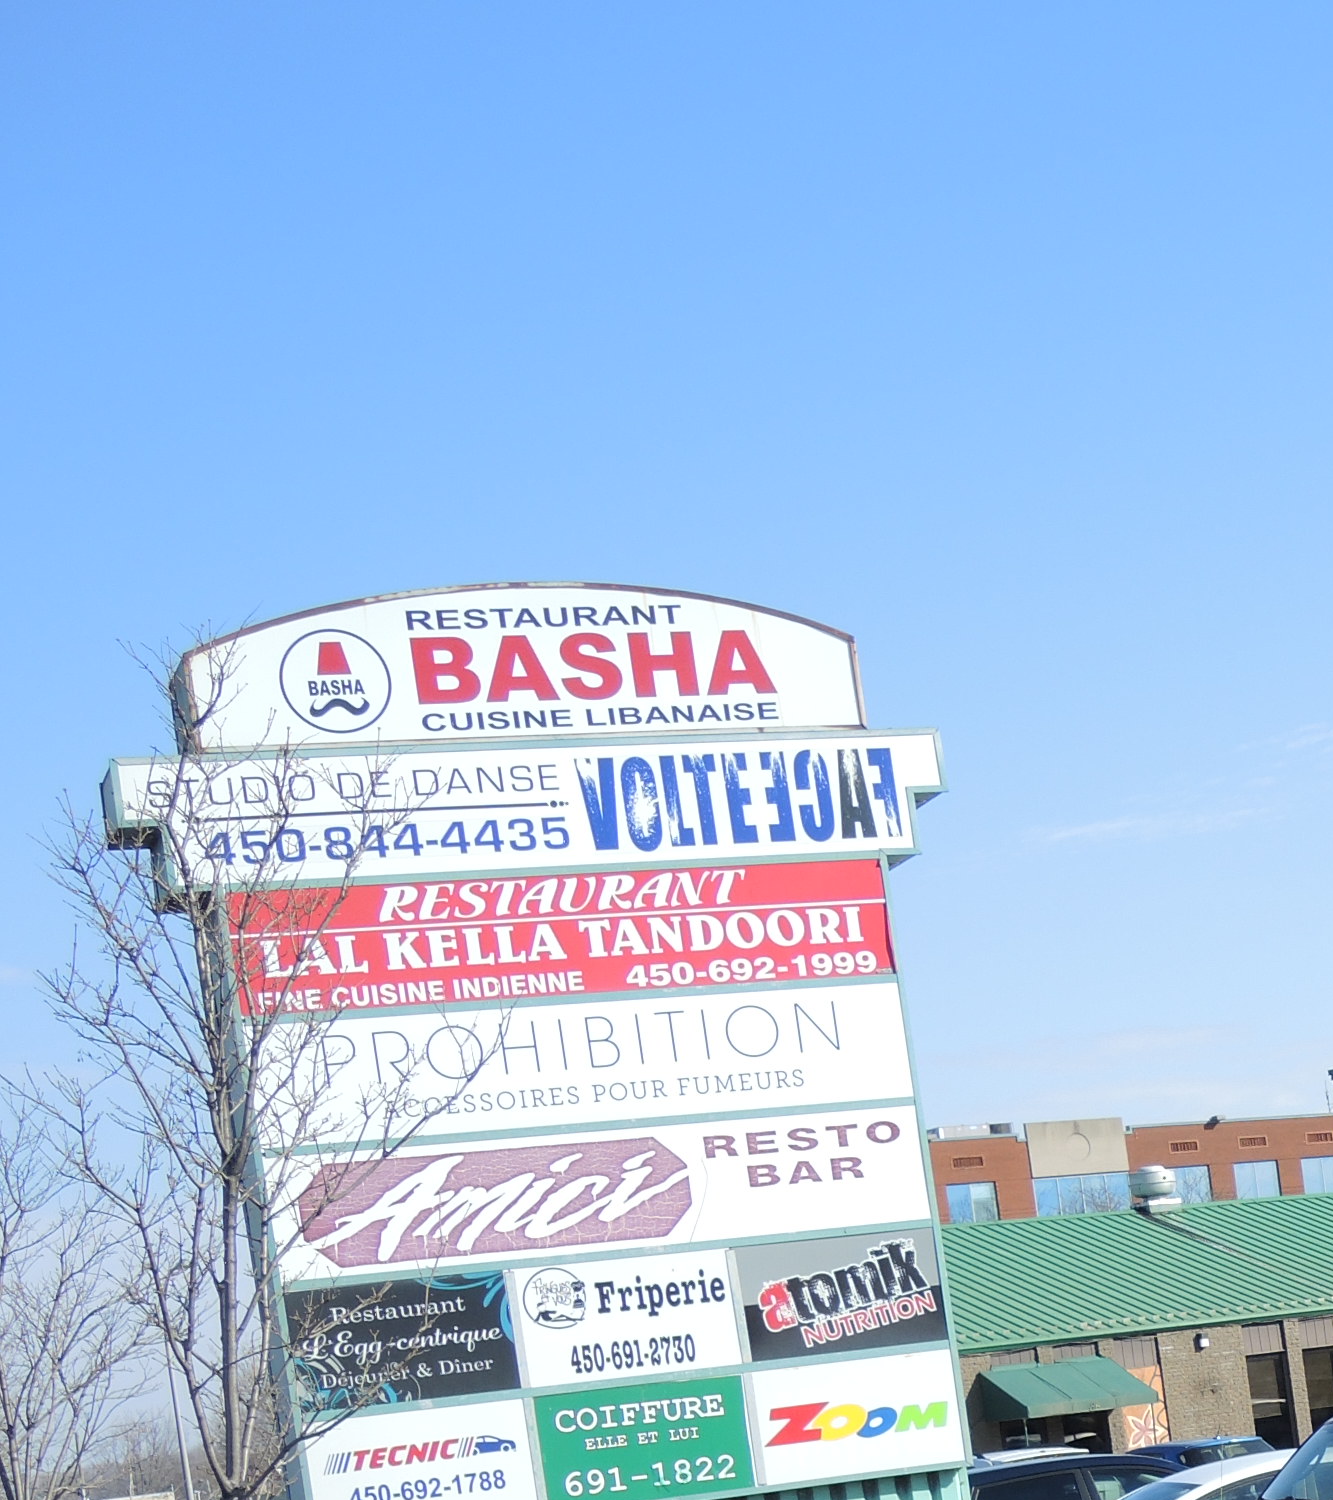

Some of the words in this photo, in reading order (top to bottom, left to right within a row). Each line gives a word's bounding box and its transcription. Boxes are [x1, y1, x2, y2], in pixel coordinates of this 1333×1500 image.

[405, 604, 682, 631] RESTAURANT
[308, 679, 365, 697] BASHA
[409, 629, 779, 705] BASHA
[422, 706, 573, 732] CUISINE
[586, 701, 779, 726] LIBANAISE
[147, 772, 316, 808] STUDIO
[337, 771, 393, 800] DE
[412, 762, 560, 797] DANSE
[203, 815, 572, 866] 450-844-4435
[378, 868, 746, 924] RESTAURANT
[258, 934, 369, 979] LAL
[383, 924, 567, 971] KELLA
[579, 905, 865, 959] TANDOORI
[625, 949, 878, 990] 450-692-1999
[257, 988, 325, 1013] FINE
[331, 980, 445, 1008] CUISINE
[452, 970, 585, 1000] INDIENNE
[320, 1001, 842, 1089] PROHIBITION
[385, 1086, 580, 1119] ACCESSOIRES
[592, 1078, 669, 1103] POUR
[677, 1068, 806, 1097] FUMEURS
[703, 1120, 901, 1158] RESTO
[746, 1156, 865, 1188] BAR
[315, 1150, 690, 1262] Amici
[329, 1296, 466, 1326] Restaurant
[594, 1269, 726, 1318] Friperie
[801, 1290, 938, 1347] NUTRITION
[416, 1363, 433, 1377] &
[438, 1357, 494, 1376] Dîner
[570, 1333, 696, 1374] 450-691-2730
[554, 1394, 724, 1433] COIFFURE
[765, 1401, 948, 1447] ZOOM
[352, 1438, 459, 1472] TECNIC
[585, 1434, 628, 1451] ELLE
[637, 1430, 660, 1444] ET
[669, 1427, 699, 1441] LUI
[564, 1455, 736, 1497] 691-1822
